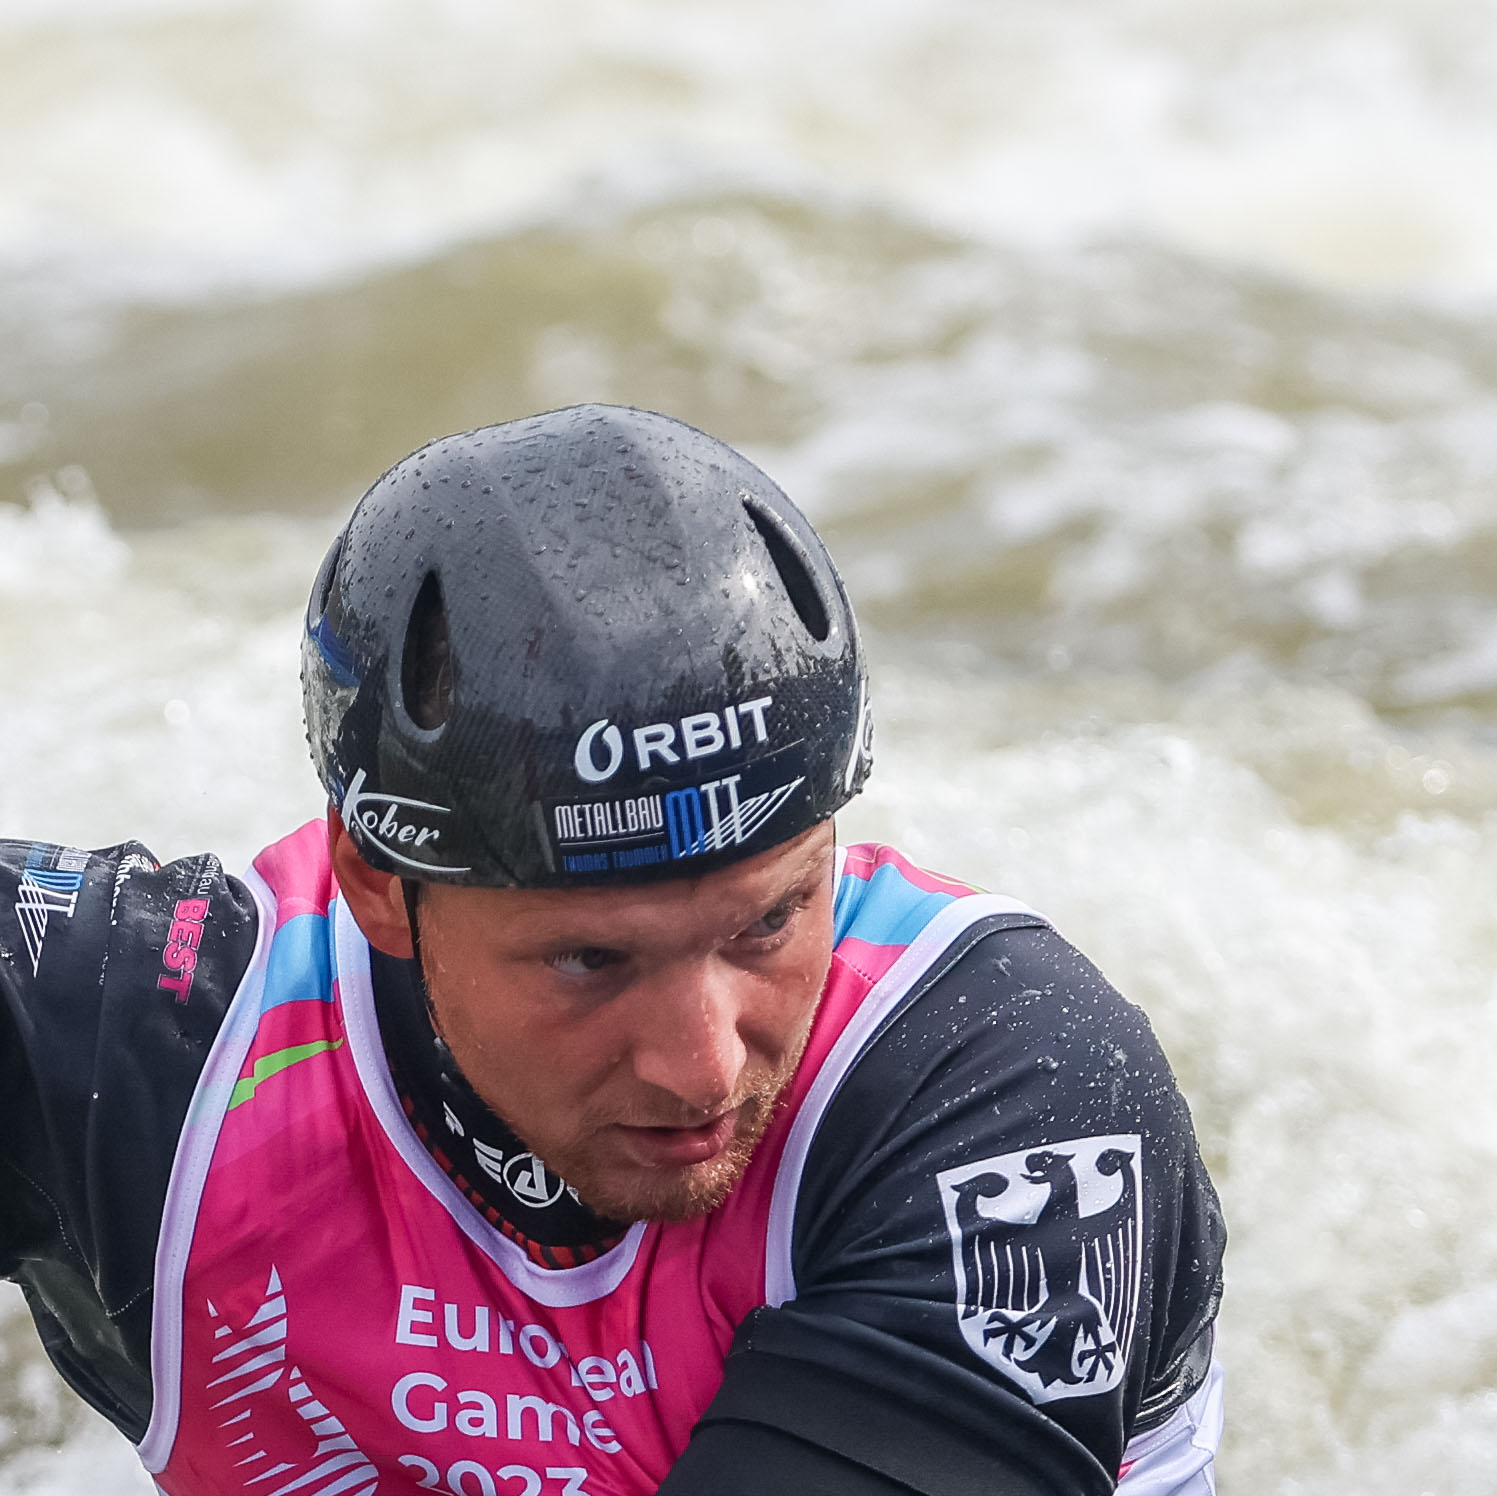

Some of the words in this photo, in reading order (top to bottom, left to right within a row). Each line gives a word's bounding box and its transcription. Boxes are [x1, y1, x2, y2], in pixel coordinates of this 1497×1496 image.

[574, 696, 772, 782] ORBIT
[341, 767, 470, 871] Kober
[555, 794, 664, 838] METALLBAU
[157, 898, 210, 1006] BEST
[391, 1371, 623, 1454] Game
